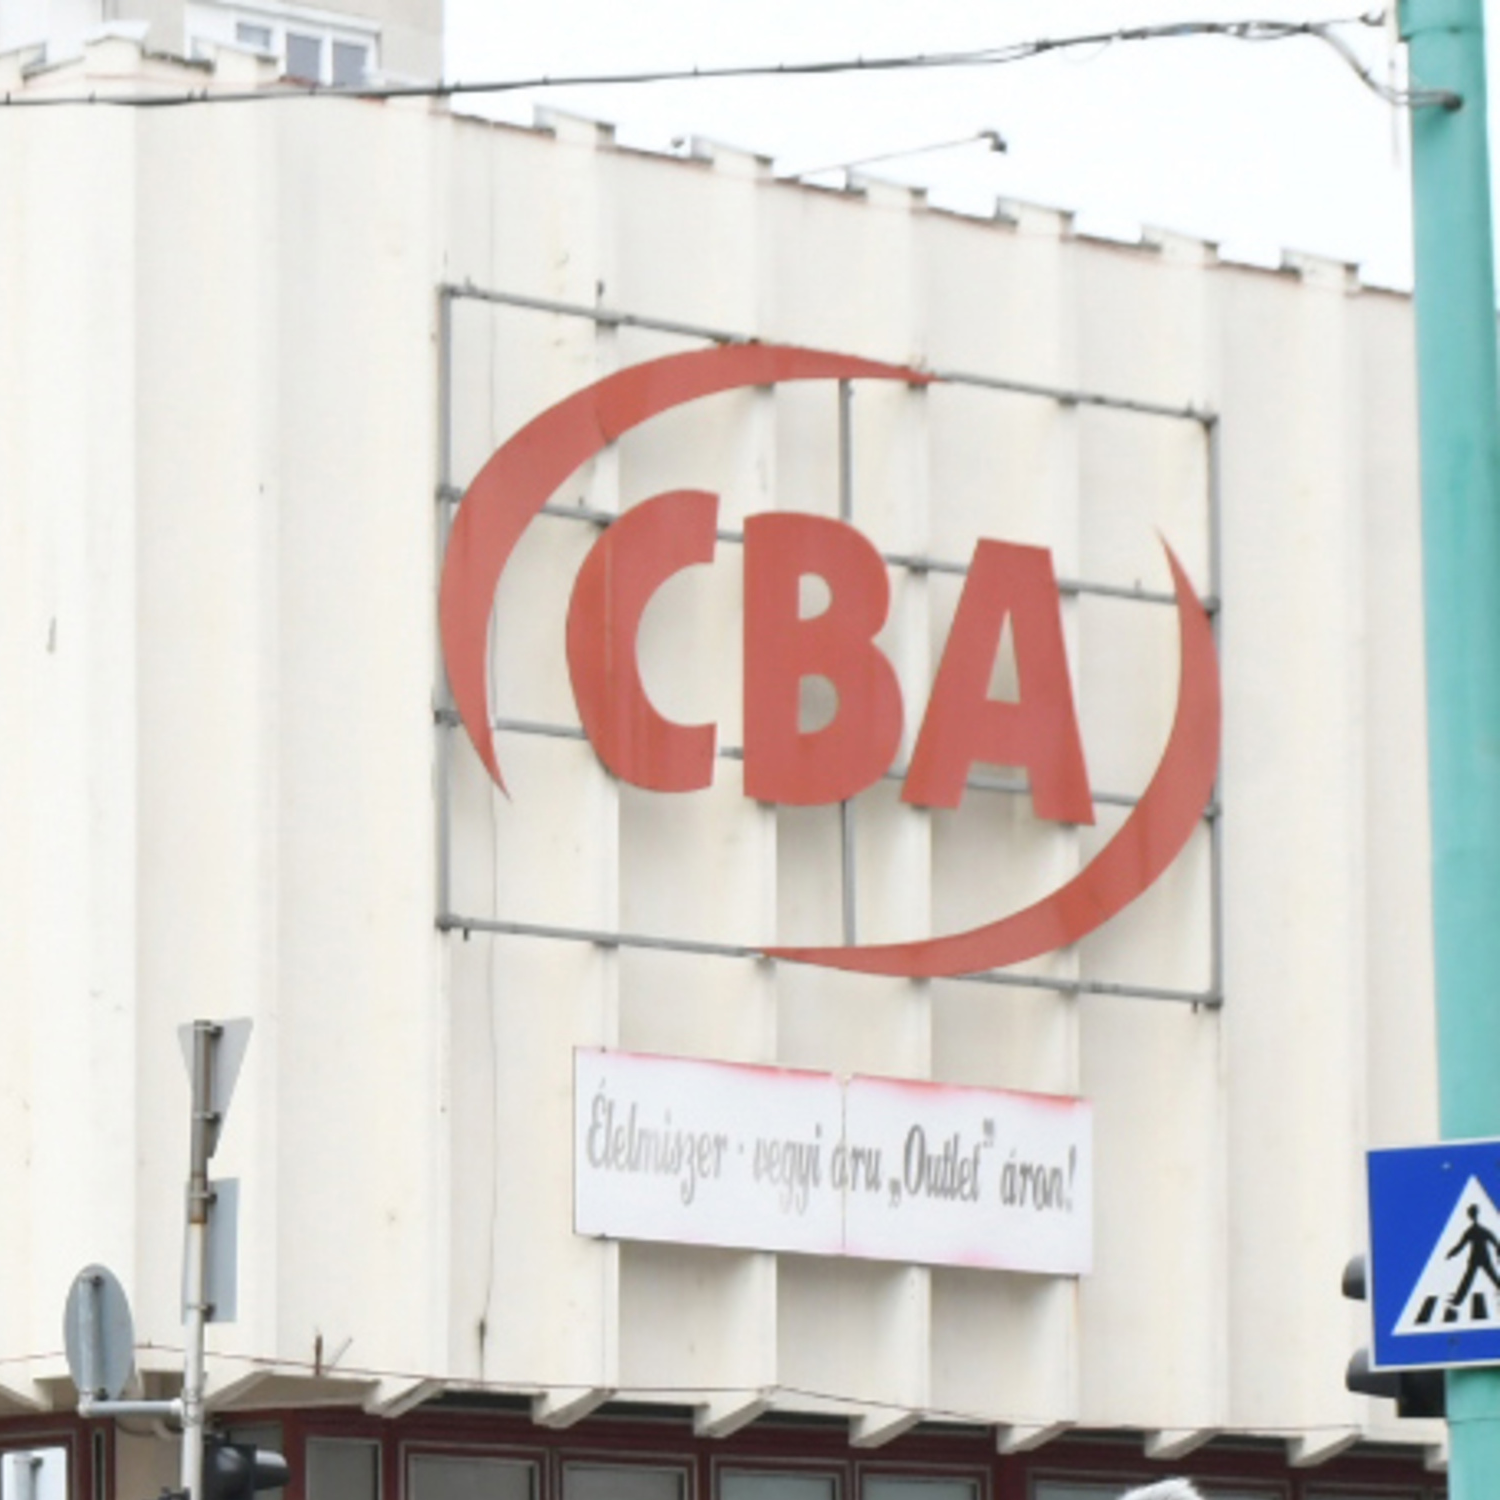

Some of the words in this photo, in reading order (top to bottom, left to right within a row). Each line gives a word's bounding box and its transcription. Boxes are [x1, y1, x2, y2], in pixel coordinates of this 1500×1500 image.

[566, 489, 1096, 826] CBA
[587, 1078, 728, 1206] Élelmiszer
[753, 1124, 822, 1215] vegyi
[1000, 1147, 1077, 1212] áron!
